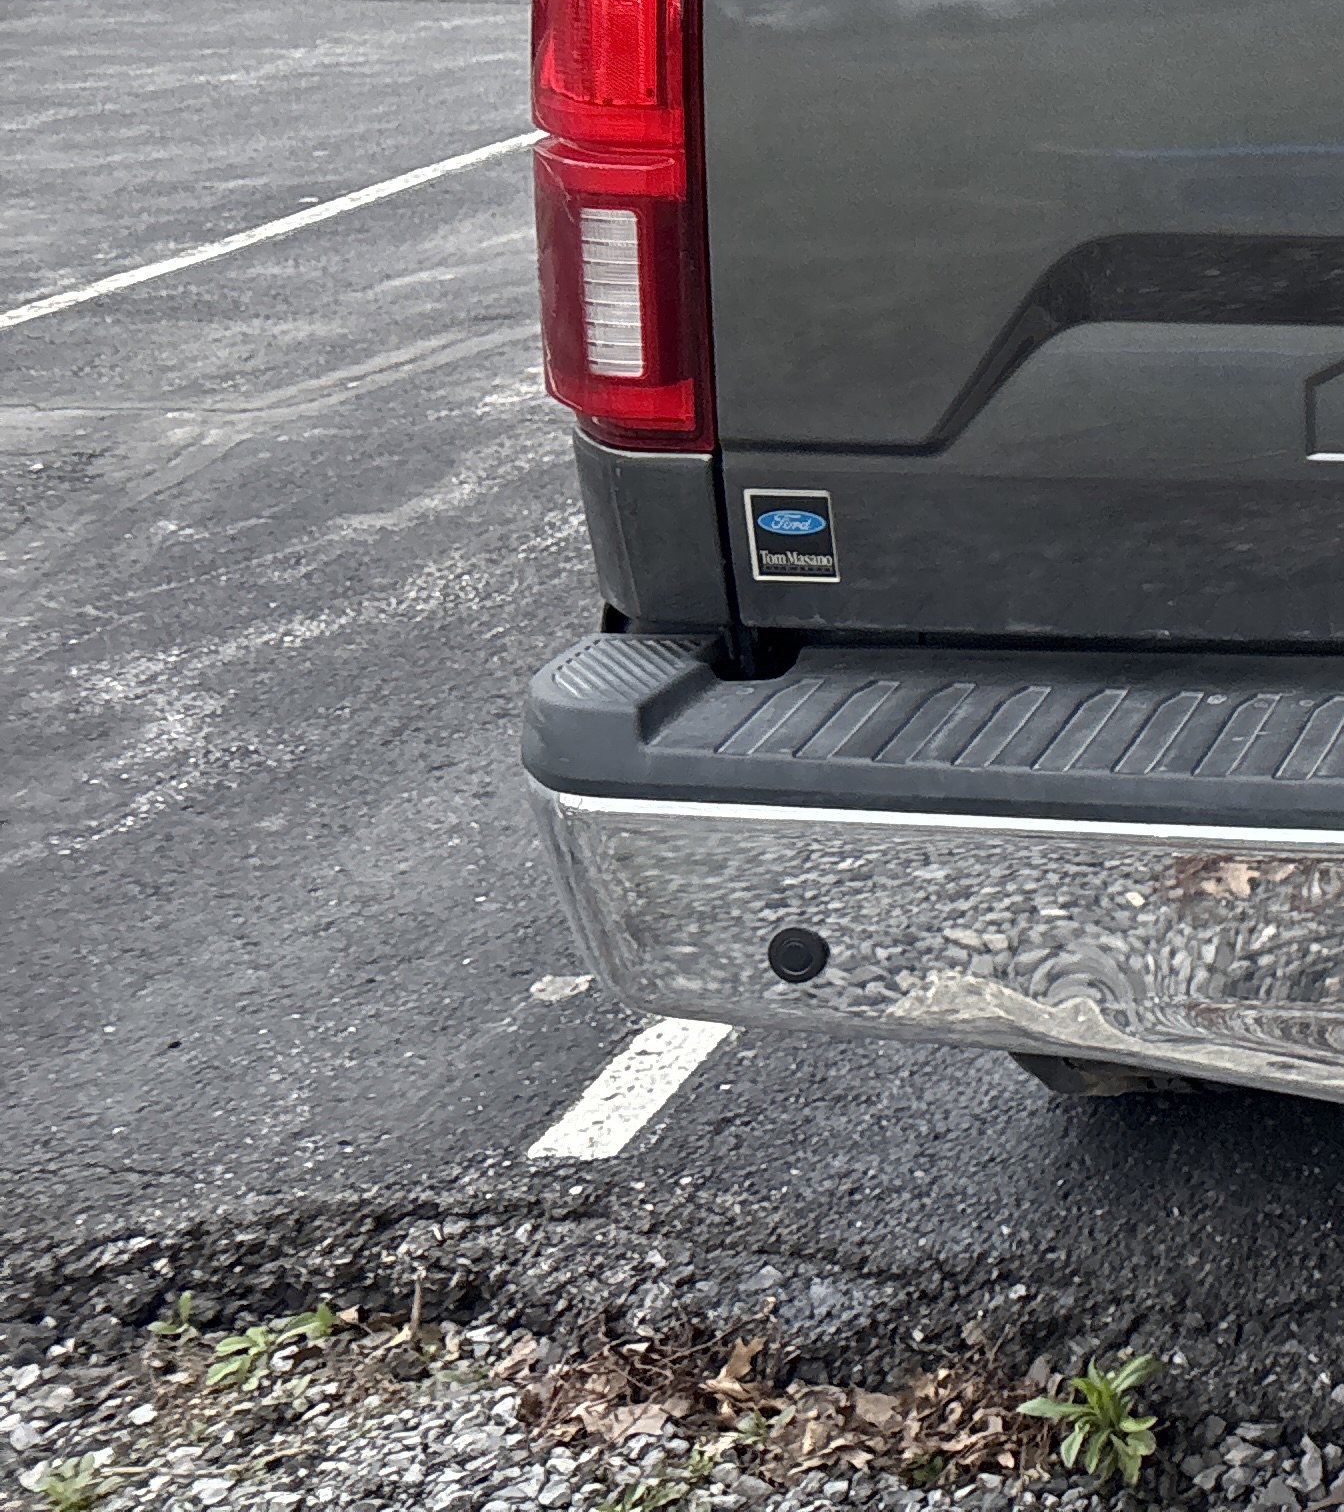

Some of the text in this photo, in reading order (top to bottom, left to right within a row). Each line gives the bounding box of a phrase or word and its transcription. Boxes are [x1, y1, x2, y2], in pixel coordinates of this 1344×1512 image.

[771, 514, 811, 530] Ford
[760, 550, 833, 566] Tom Masano
